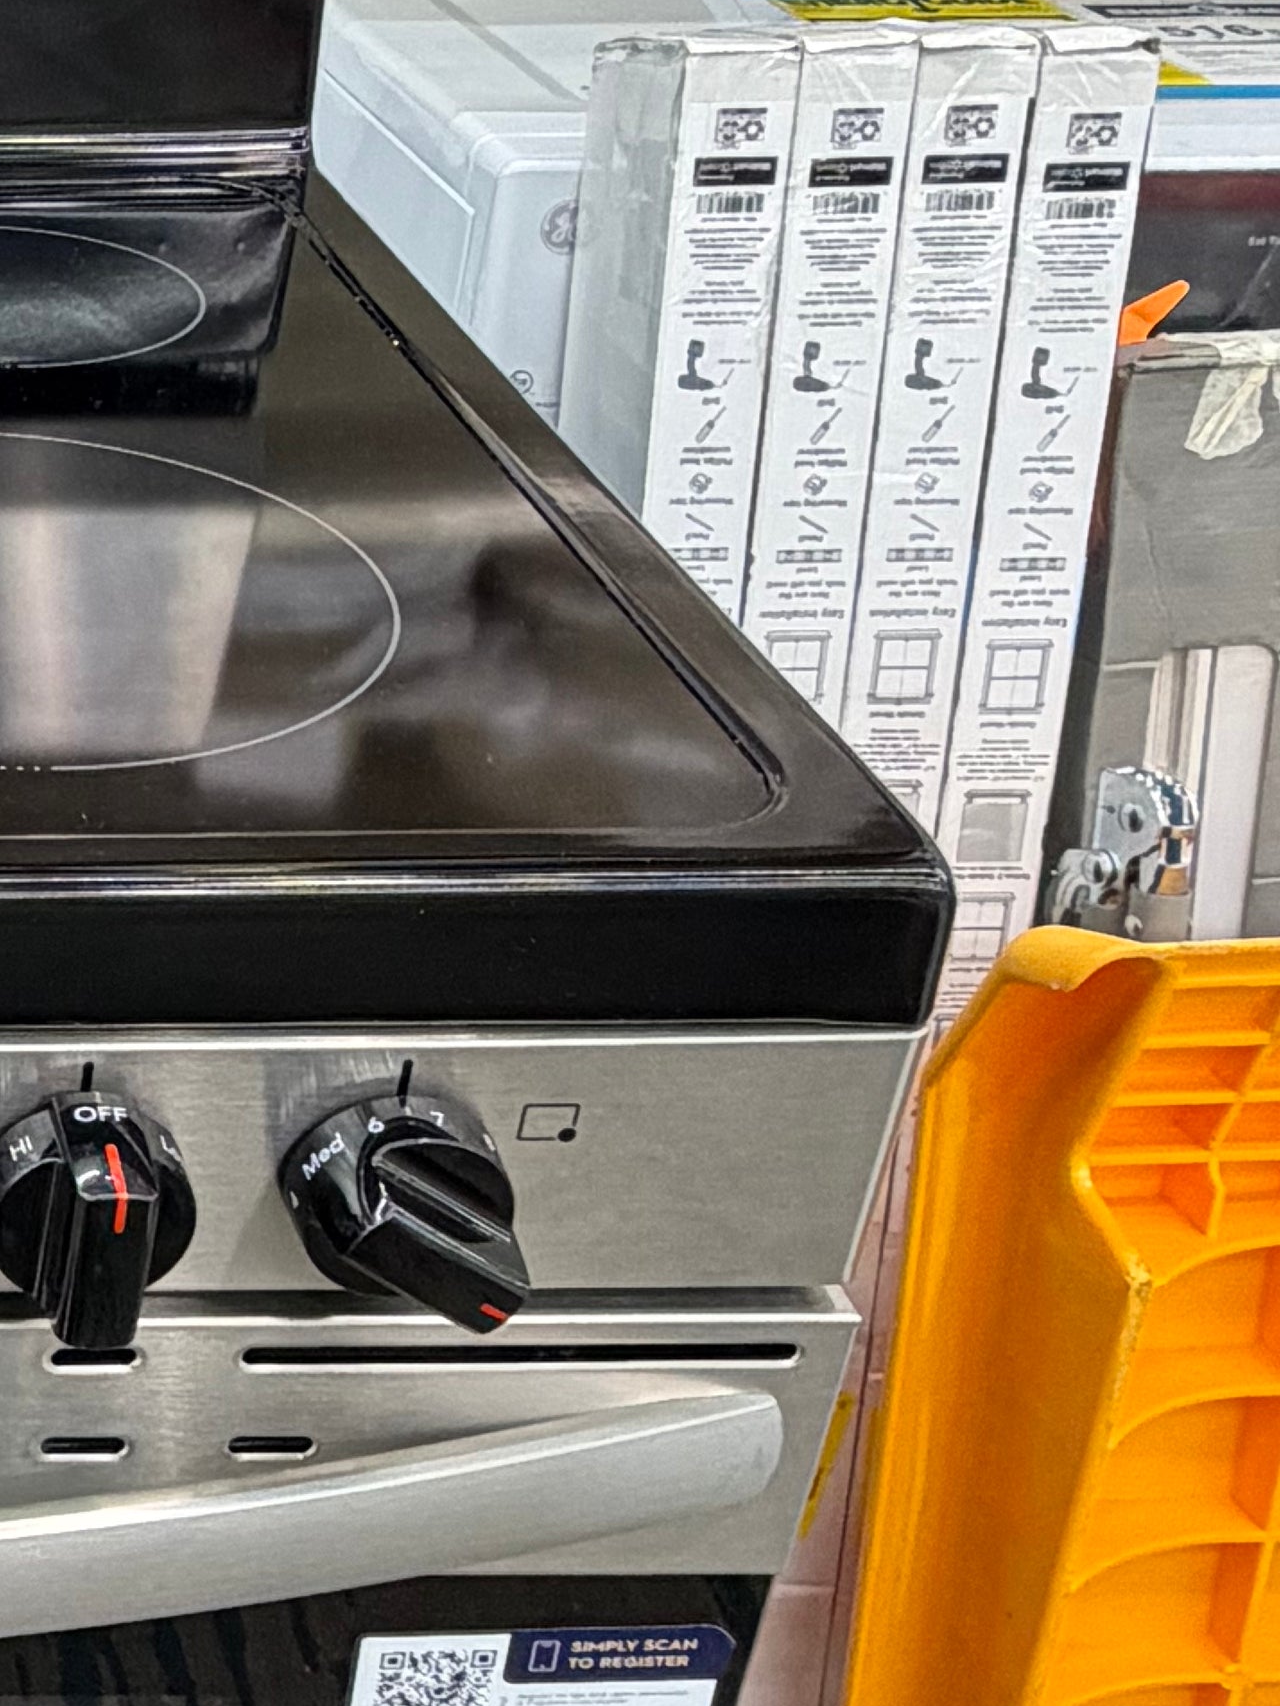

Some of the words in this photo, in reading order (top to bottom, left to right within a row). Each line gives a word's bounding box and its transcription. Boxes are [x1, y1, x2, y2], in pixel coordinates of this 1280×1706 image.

[73, 1106, 129, 1123] OFF
[367, 1116, 385, 1134] 6
[570, 1639, 640, 1653] SIMPLY
[643, 1638, 698, 1651] SCAN
[568, 1657, 595, 1670] TO
[599, 1655, 690, 1669] REGISTER
